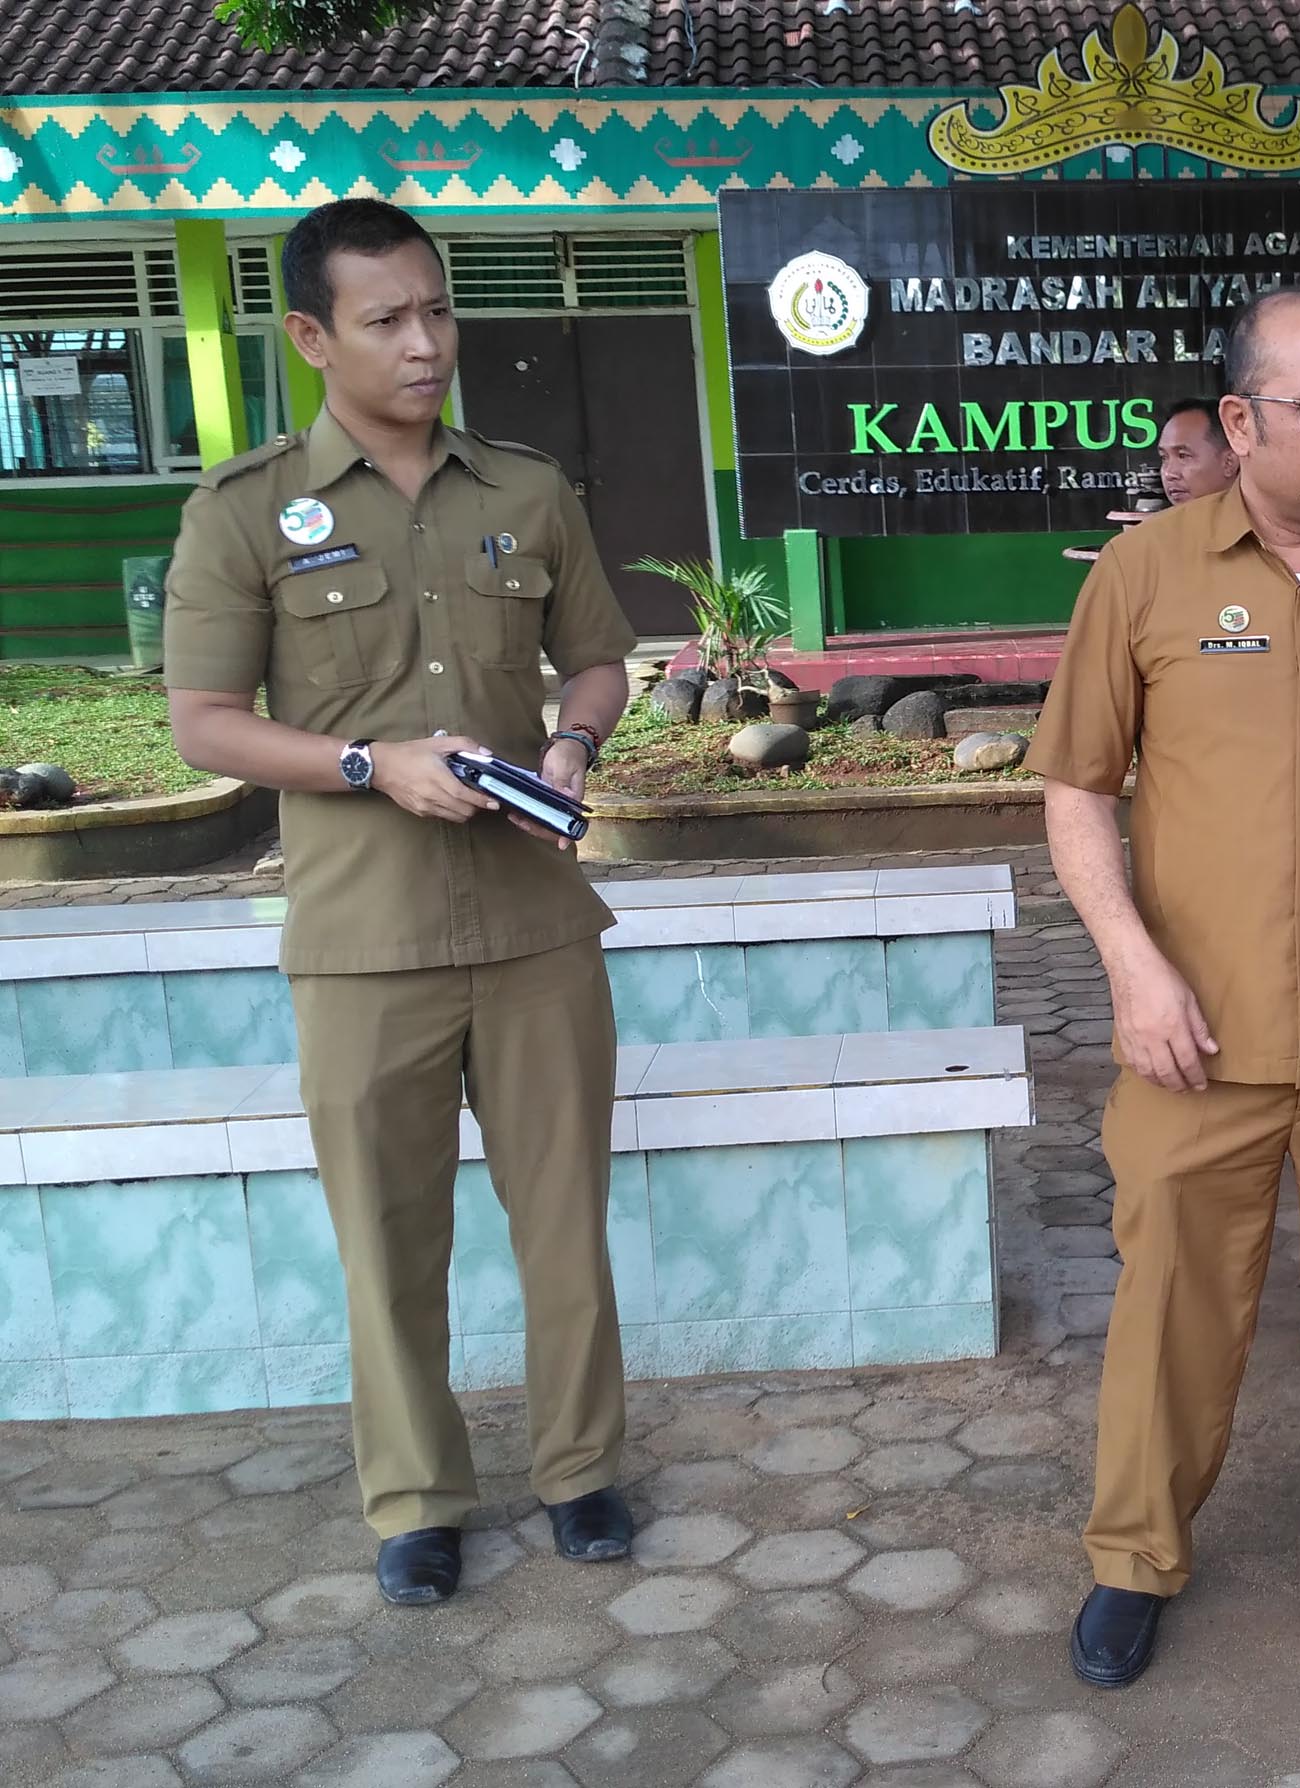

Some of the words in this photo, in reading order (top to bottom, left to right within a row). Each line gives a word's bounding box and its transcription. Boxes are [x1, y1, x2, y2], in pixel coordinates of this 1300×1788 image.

[1006, 234, 1234, 259] KEMENTERIAN
[890, 276, 1122, 312] MADRASAH
[1136, 272, 1281, 309] ALIYAH
[963, 330, 1160, 367] BANDAR
[847, 399, 1158, 454] KAMPUS
[799, 469, 907, 498] Cerdas,
[915, 467, 1050, 494] Edukatif,
[1238, 640, 1261, 648] IQBAL
